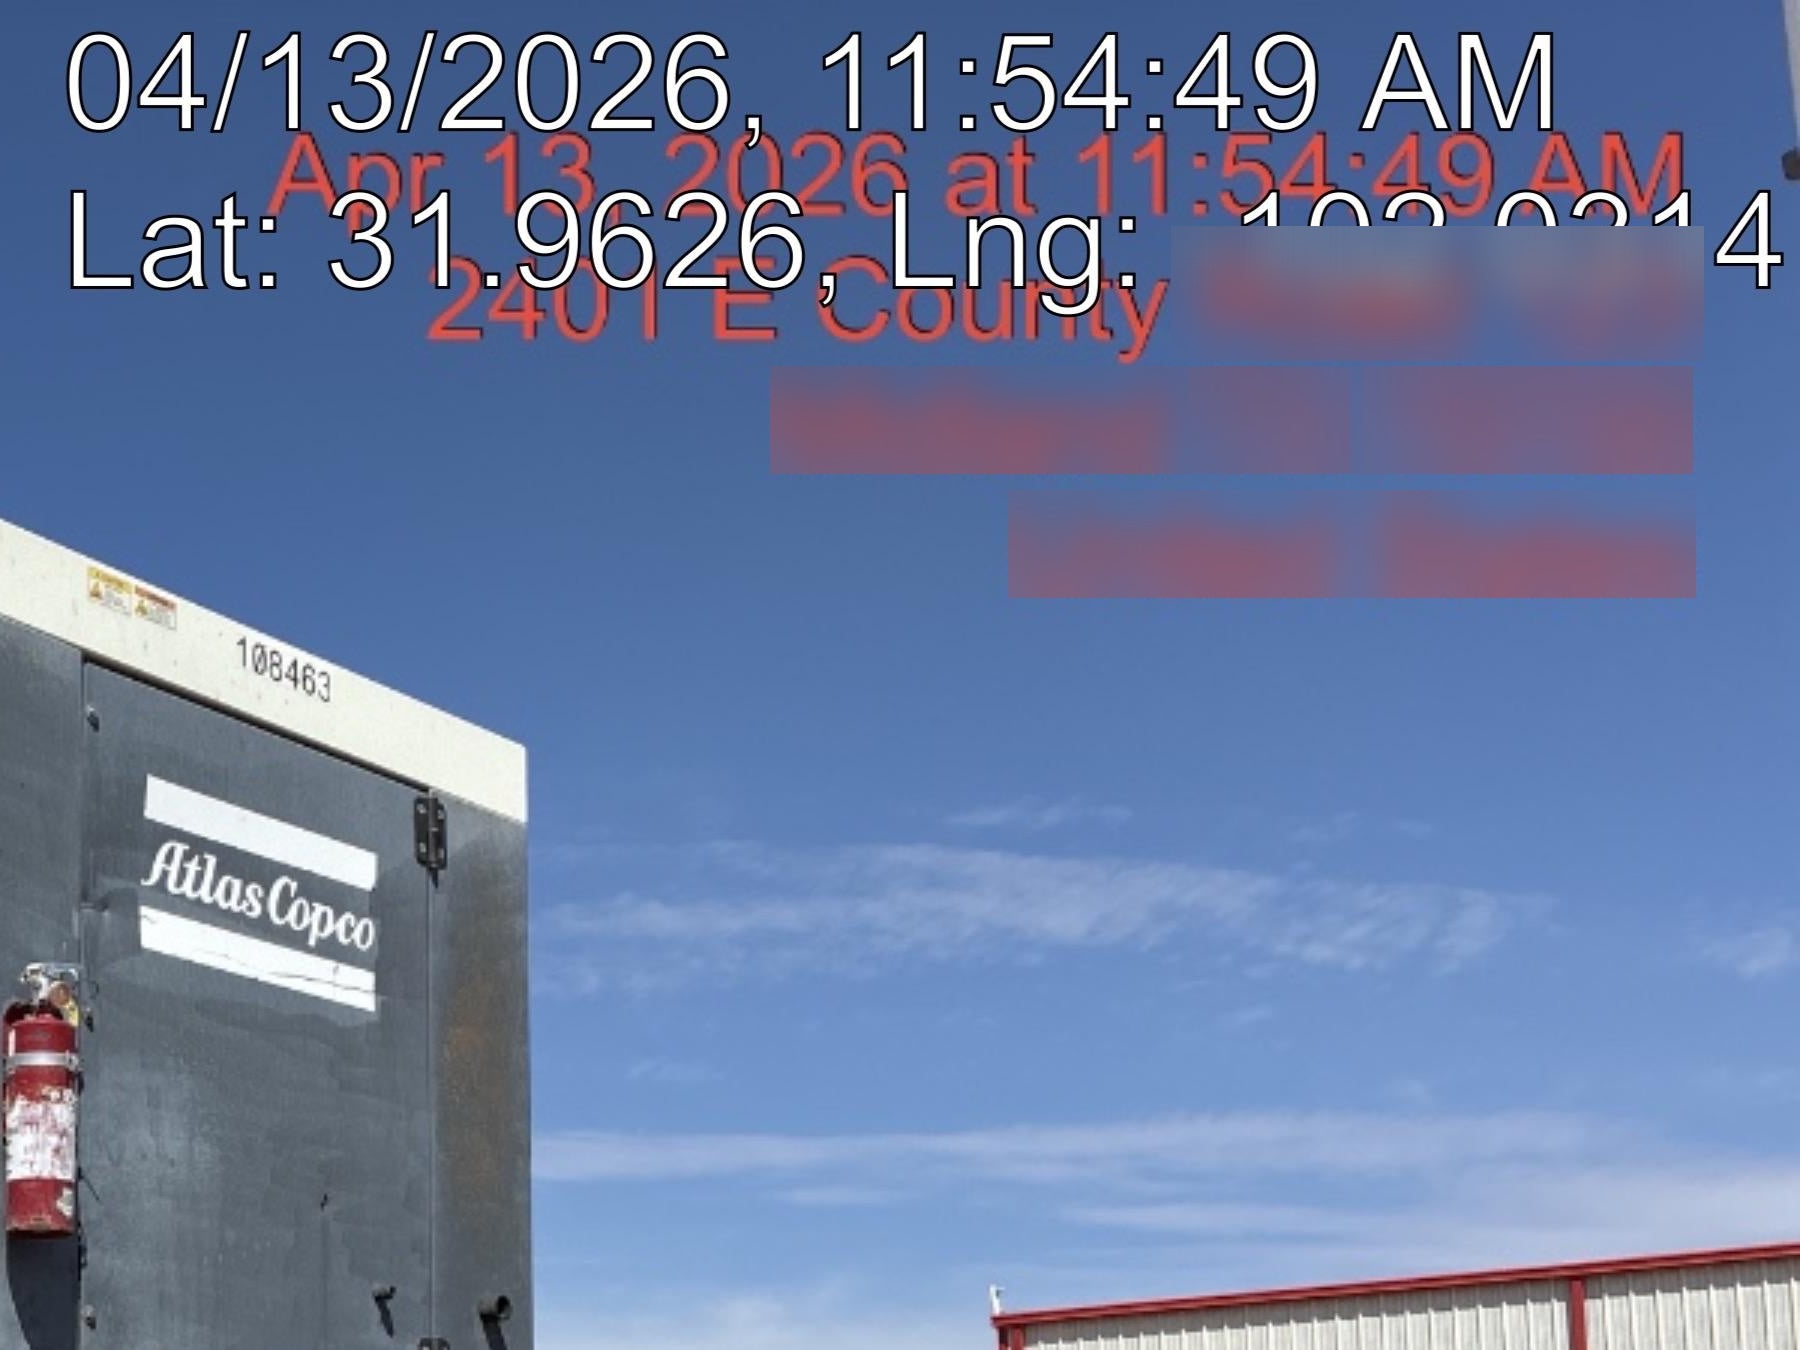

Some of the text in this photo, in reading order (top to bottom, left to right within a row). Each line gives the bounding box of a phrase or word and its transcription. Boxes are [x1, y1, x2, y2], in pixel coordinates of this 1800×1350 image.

[237, 635, 332, 703] 108463
[140, 840, 376, 952] Atlas Copco
